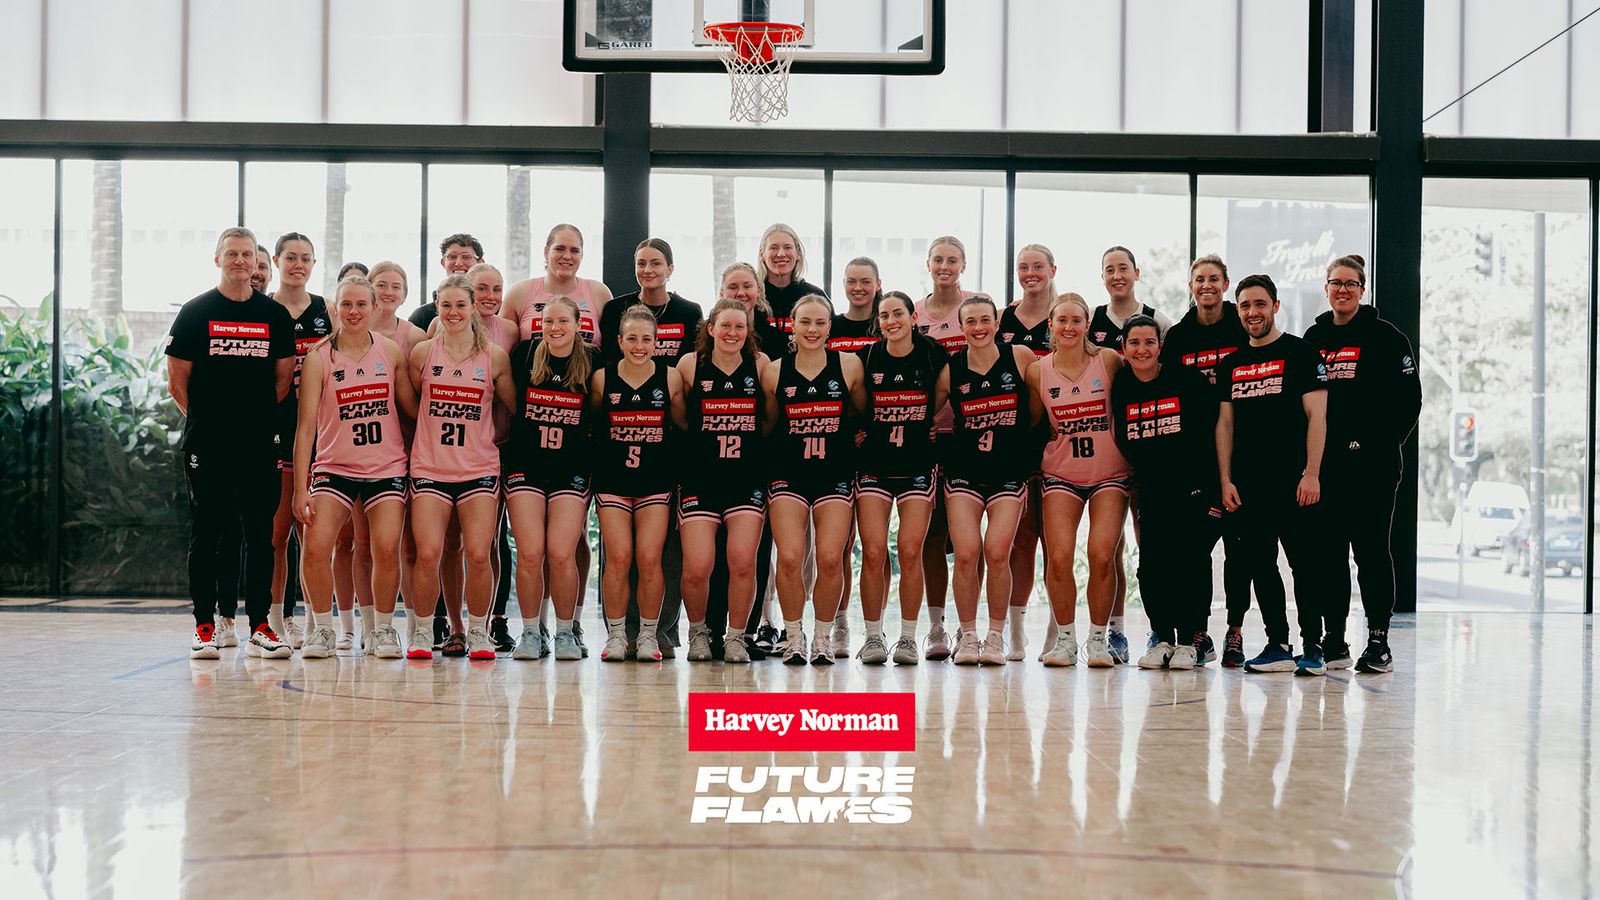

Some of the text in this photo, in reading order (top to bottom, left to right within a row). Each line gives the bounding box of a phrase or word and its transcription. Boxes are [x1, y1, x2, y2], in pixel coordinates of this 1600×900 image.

[213, 325, 238, 333] Harvey
[210, 339, 270, 349] FUTURE
[209, 348, 268, 357] FLAMES
[1232, 377, 1283, 392] FUTURE
[341, 390, 363, 399] Harvey
[432, 388, 480, 398] Harvey Norman
[530, 392, 580, 404] Harvey Norman
[339, 400, 388, 413] FUTURE
[430, 401, 481, 413] FUTURE
[526, 404, 581, 417] FUTURE
[874, 405, 927, 414] FUTURE
[964, 402, 987, 411] Harvey
[340, 408, 389, 421] FLAMES
[429, 409, 481, 421] FLAMES
[525, 412, 580, 425] FLAMES
[874, 413, 926, 422] FLAMES
[966, 410, 1017, 422] FUTURE
[789, 417, 840, 427] FUTURE
[965, 418, 1016, 430] FLAMES
[1058, 416, 1107, 428] FUTURE
[352, 421, 382, 446] 30
[441, 422, 465, 446] 21
[610, 427, 663, 435] FUTURE
[789, 425, 839, 434] FLAMES
[1058, 424, 1109, 435] FLAMES
[539, 426, 564, 450] 19
[610, 433, 663, 442] FLAMES
[889, 426, 904, 447] 4
[978, 430, 993, 452] 9
[717, 435, 741, 458] 12
[803, 437, 826, 459] 14
[1069, 437, 1094, 458] 18
[625, 446, 641, 468] 5
